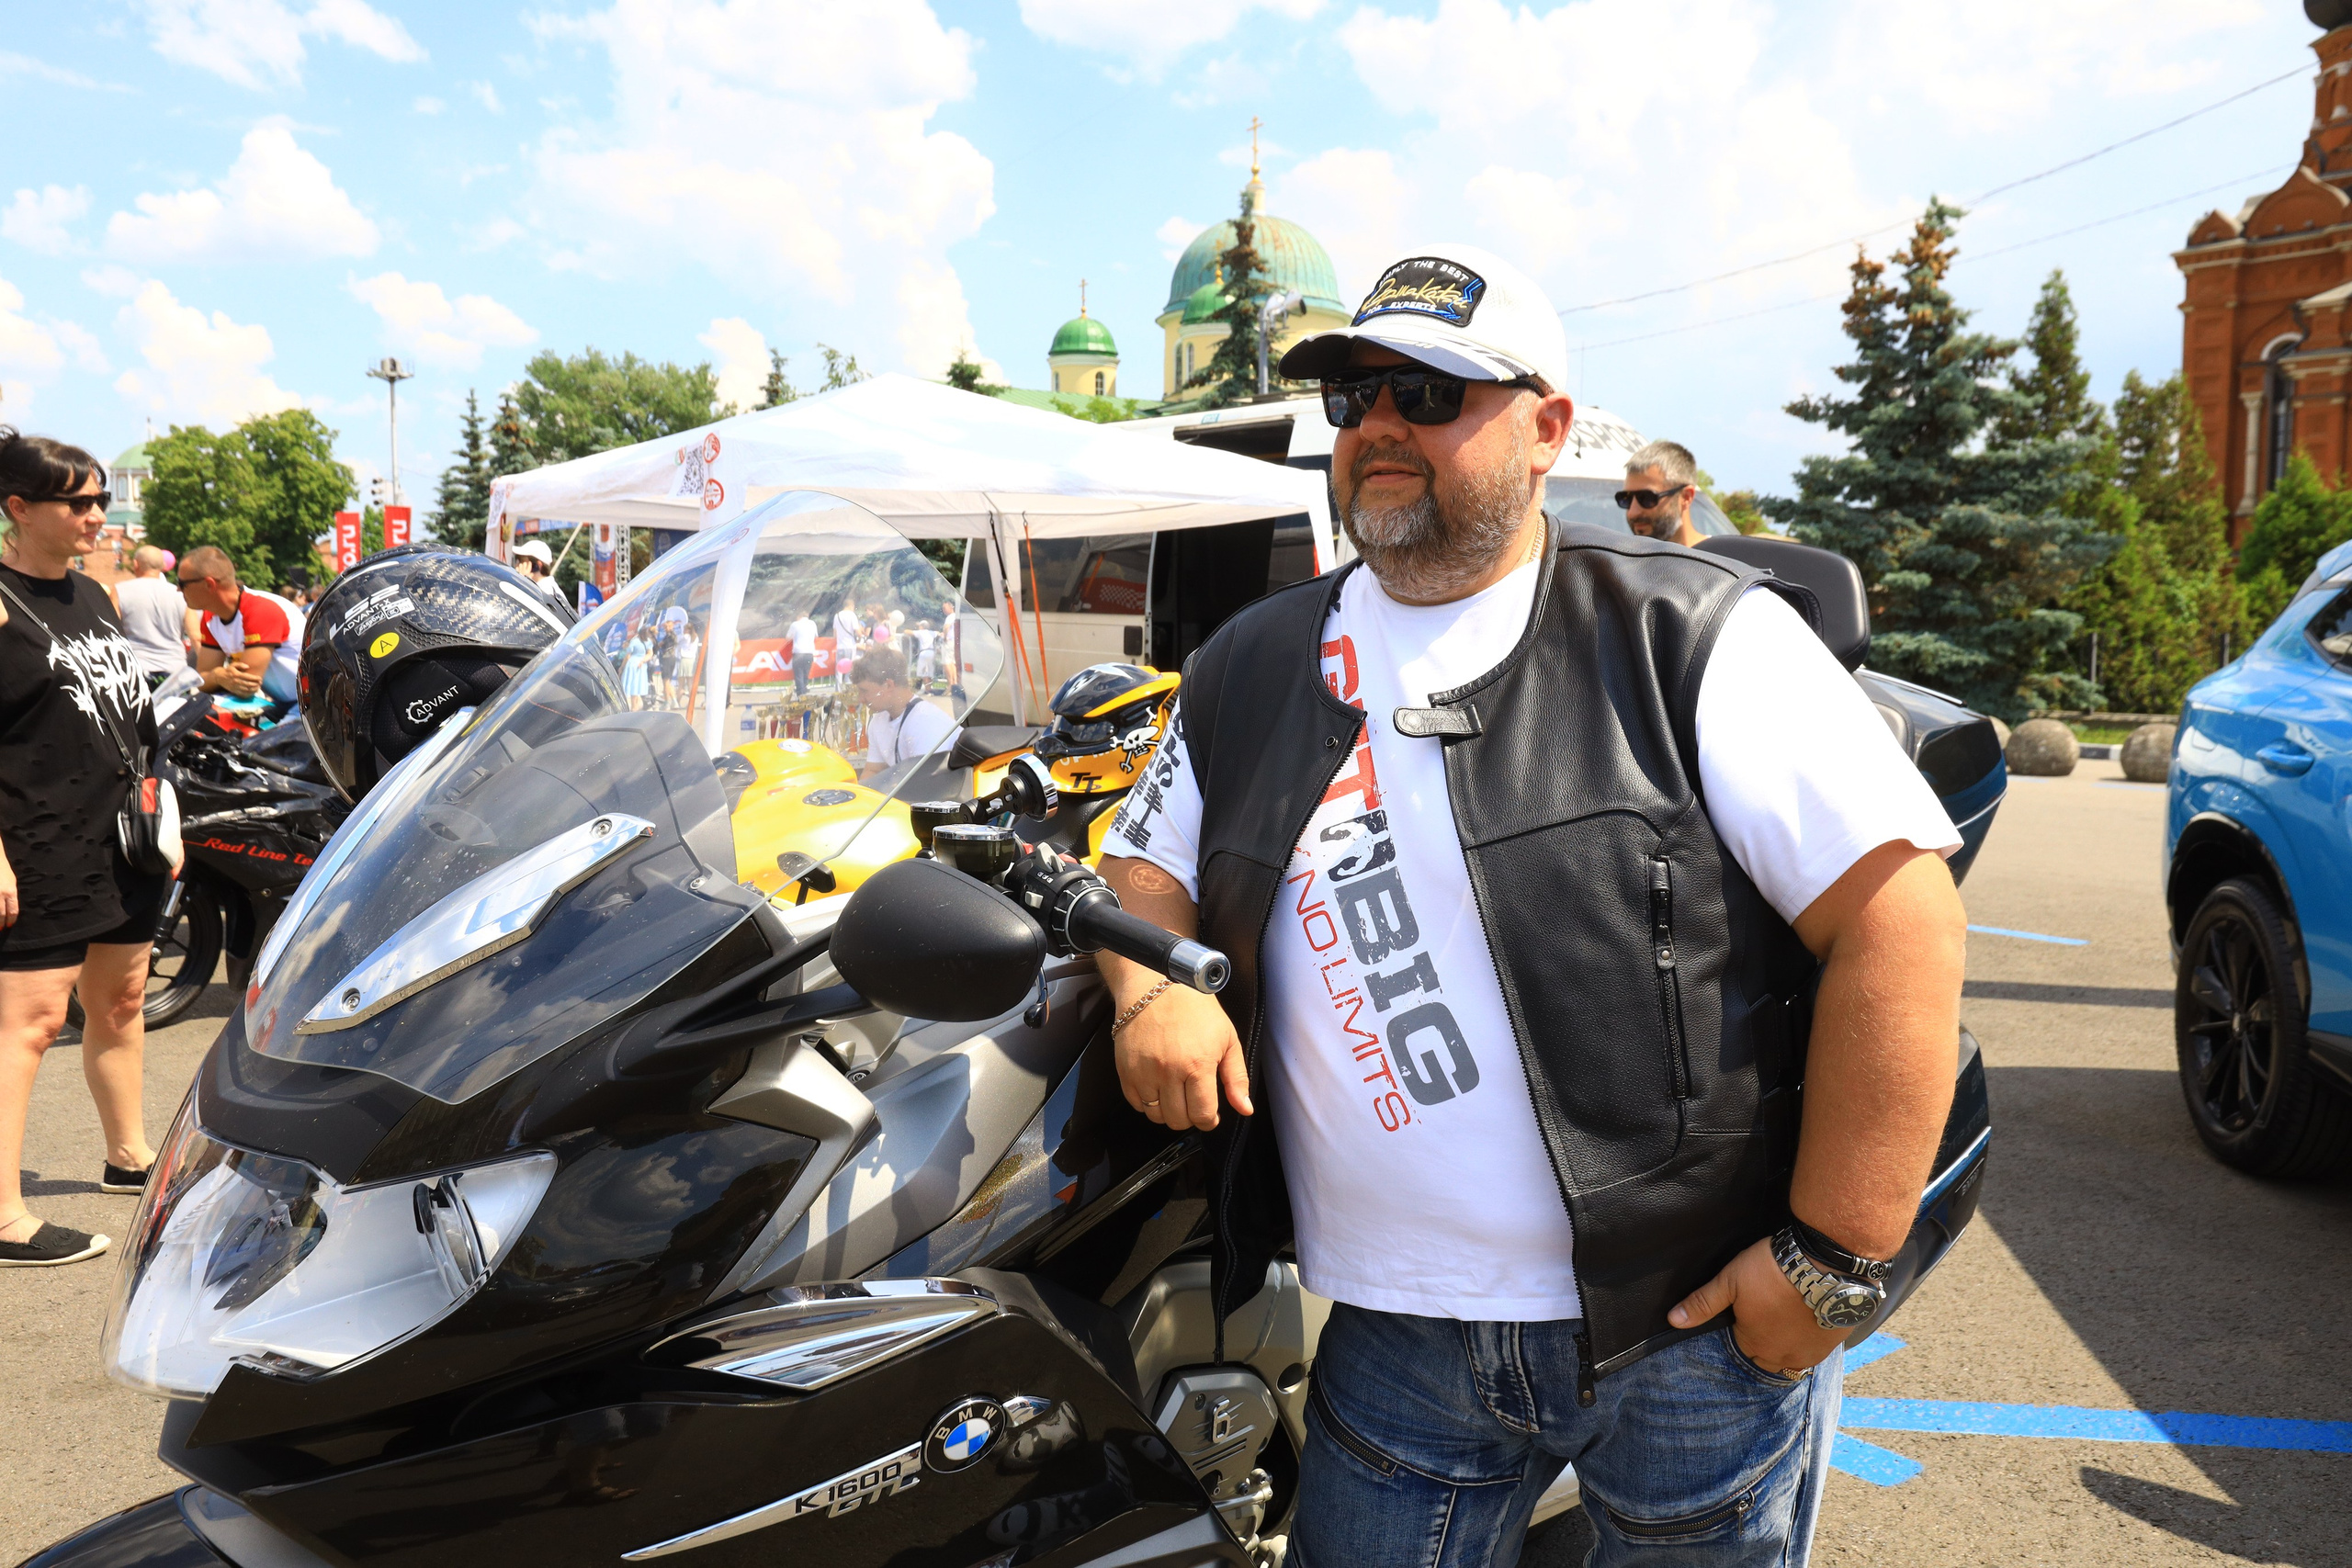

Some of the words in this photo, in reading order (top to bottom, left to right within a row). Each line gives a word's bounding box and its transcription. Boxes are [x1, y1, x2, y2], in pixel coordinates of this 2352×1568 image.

[1379, 262, 1408, 288] SIMPLY
[1413, 261, 1435, 269] THE
[1440, 264, 1469, 281] BEST
[1390, 299, 1438, 312] EXPERTS
[342, 525, 357, 568] o.ru
[329, 584, 400, 640] LS2
[343, 598, 391, 635] ADVANT-X
[379, 639, 393, 653] A
[415, 685, 460, 717] ADVANT
[1069, 772, 1103, 793] TT
[206, 837, 246, 853] Red
[247, 845, 288, 862] Line
[293, 852, 314, 865] Te
[1286, 869, 1339, 953] NO
[1320, 957, 1412, 1133] LIMITS
[1334, 865, 1480, 1106] BIG
[935, 1405, 998, 1439] BMW
[1213, 1396, 1231, 1444] 6
